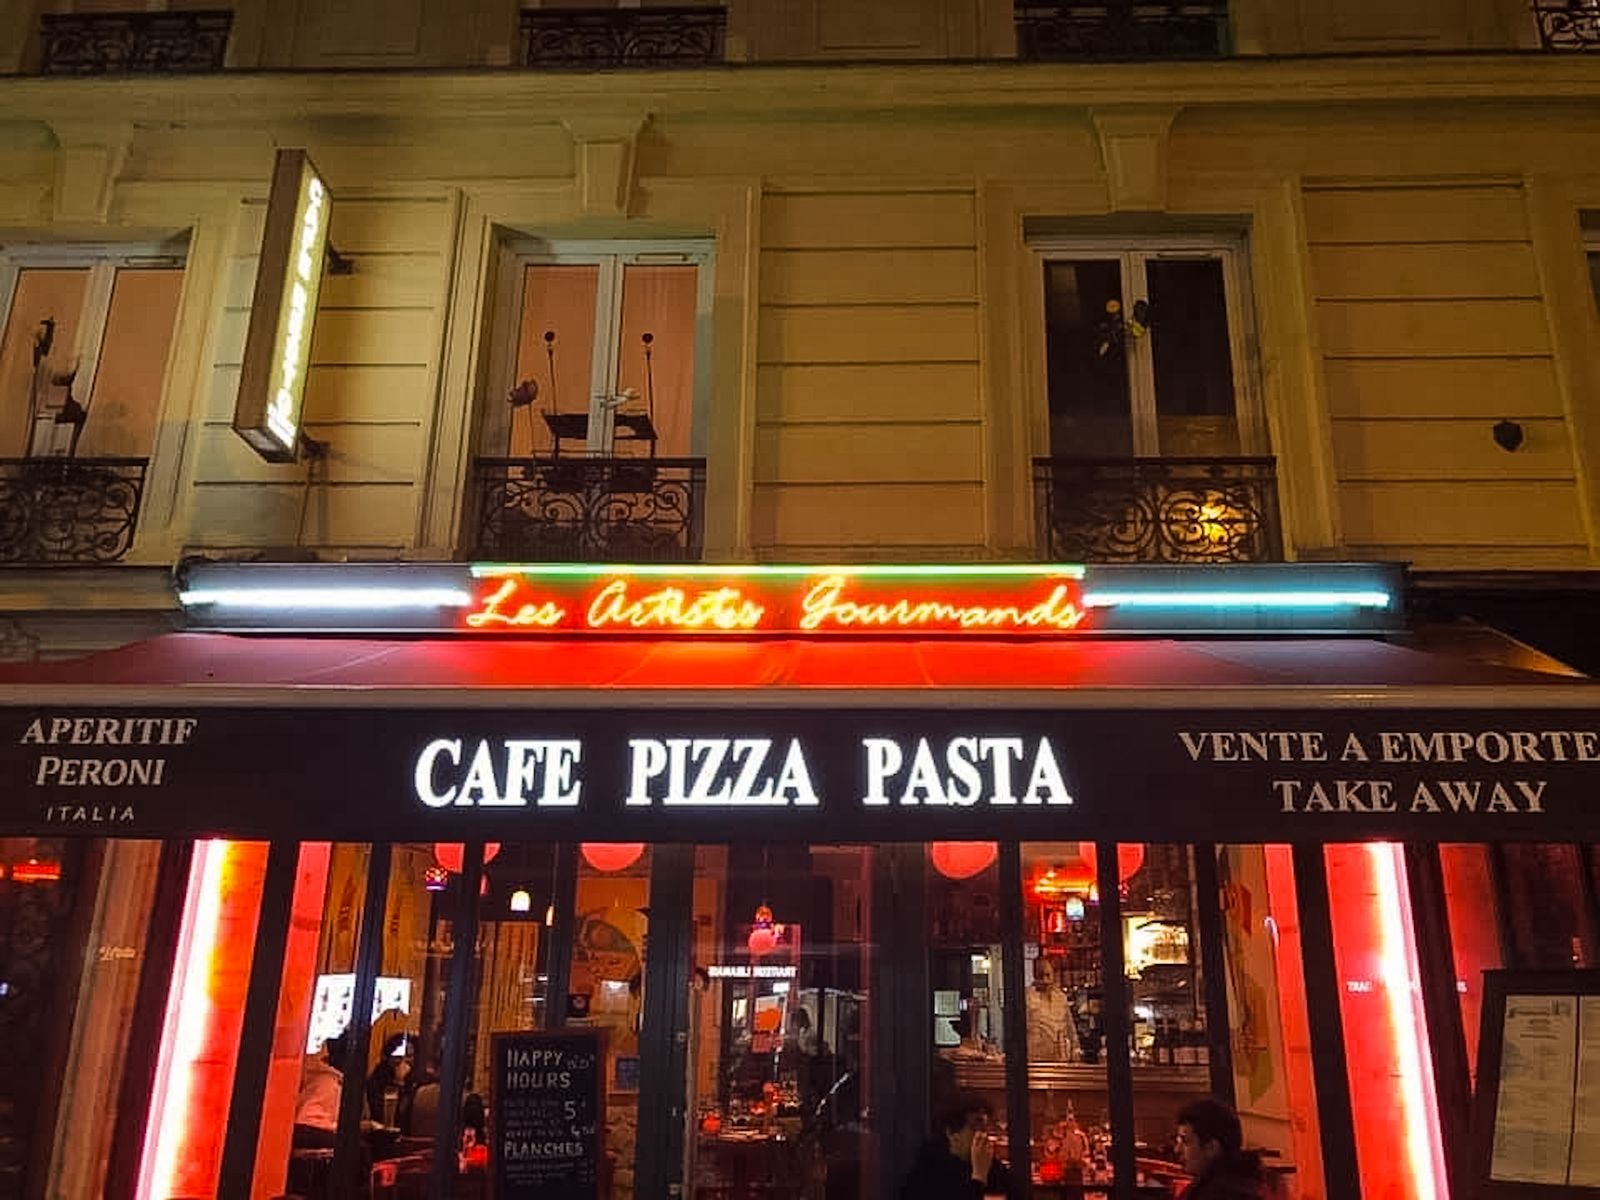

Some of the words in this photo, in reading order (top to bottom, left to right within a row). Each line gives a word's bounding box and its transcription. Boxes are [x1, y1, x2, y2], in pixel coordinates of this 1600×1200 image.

[466, 579, 564, 627] Les
[800, 574, 1085, 629] Gourmands
[20, 717, 198, 745] APERITIF
[1178, 732, 1328, 762] VENTE
[1340, 732, 1370, 762] A
[35, 755, 166, 786] PERONI
[414, 738, 582, 808] CAFE
[626, 738, 820, 806] PIZZA
[862, 737, 1073, 808] PASTA
[1273, 780, 1398, 813] TAKE
[1409, 780, 1548, 813] AWAY
[46, 805, 136, 822] ITALIA
[507, 1049, 564, 1068] HAPPY
[507, 1071, 571, 1089] HOURS
